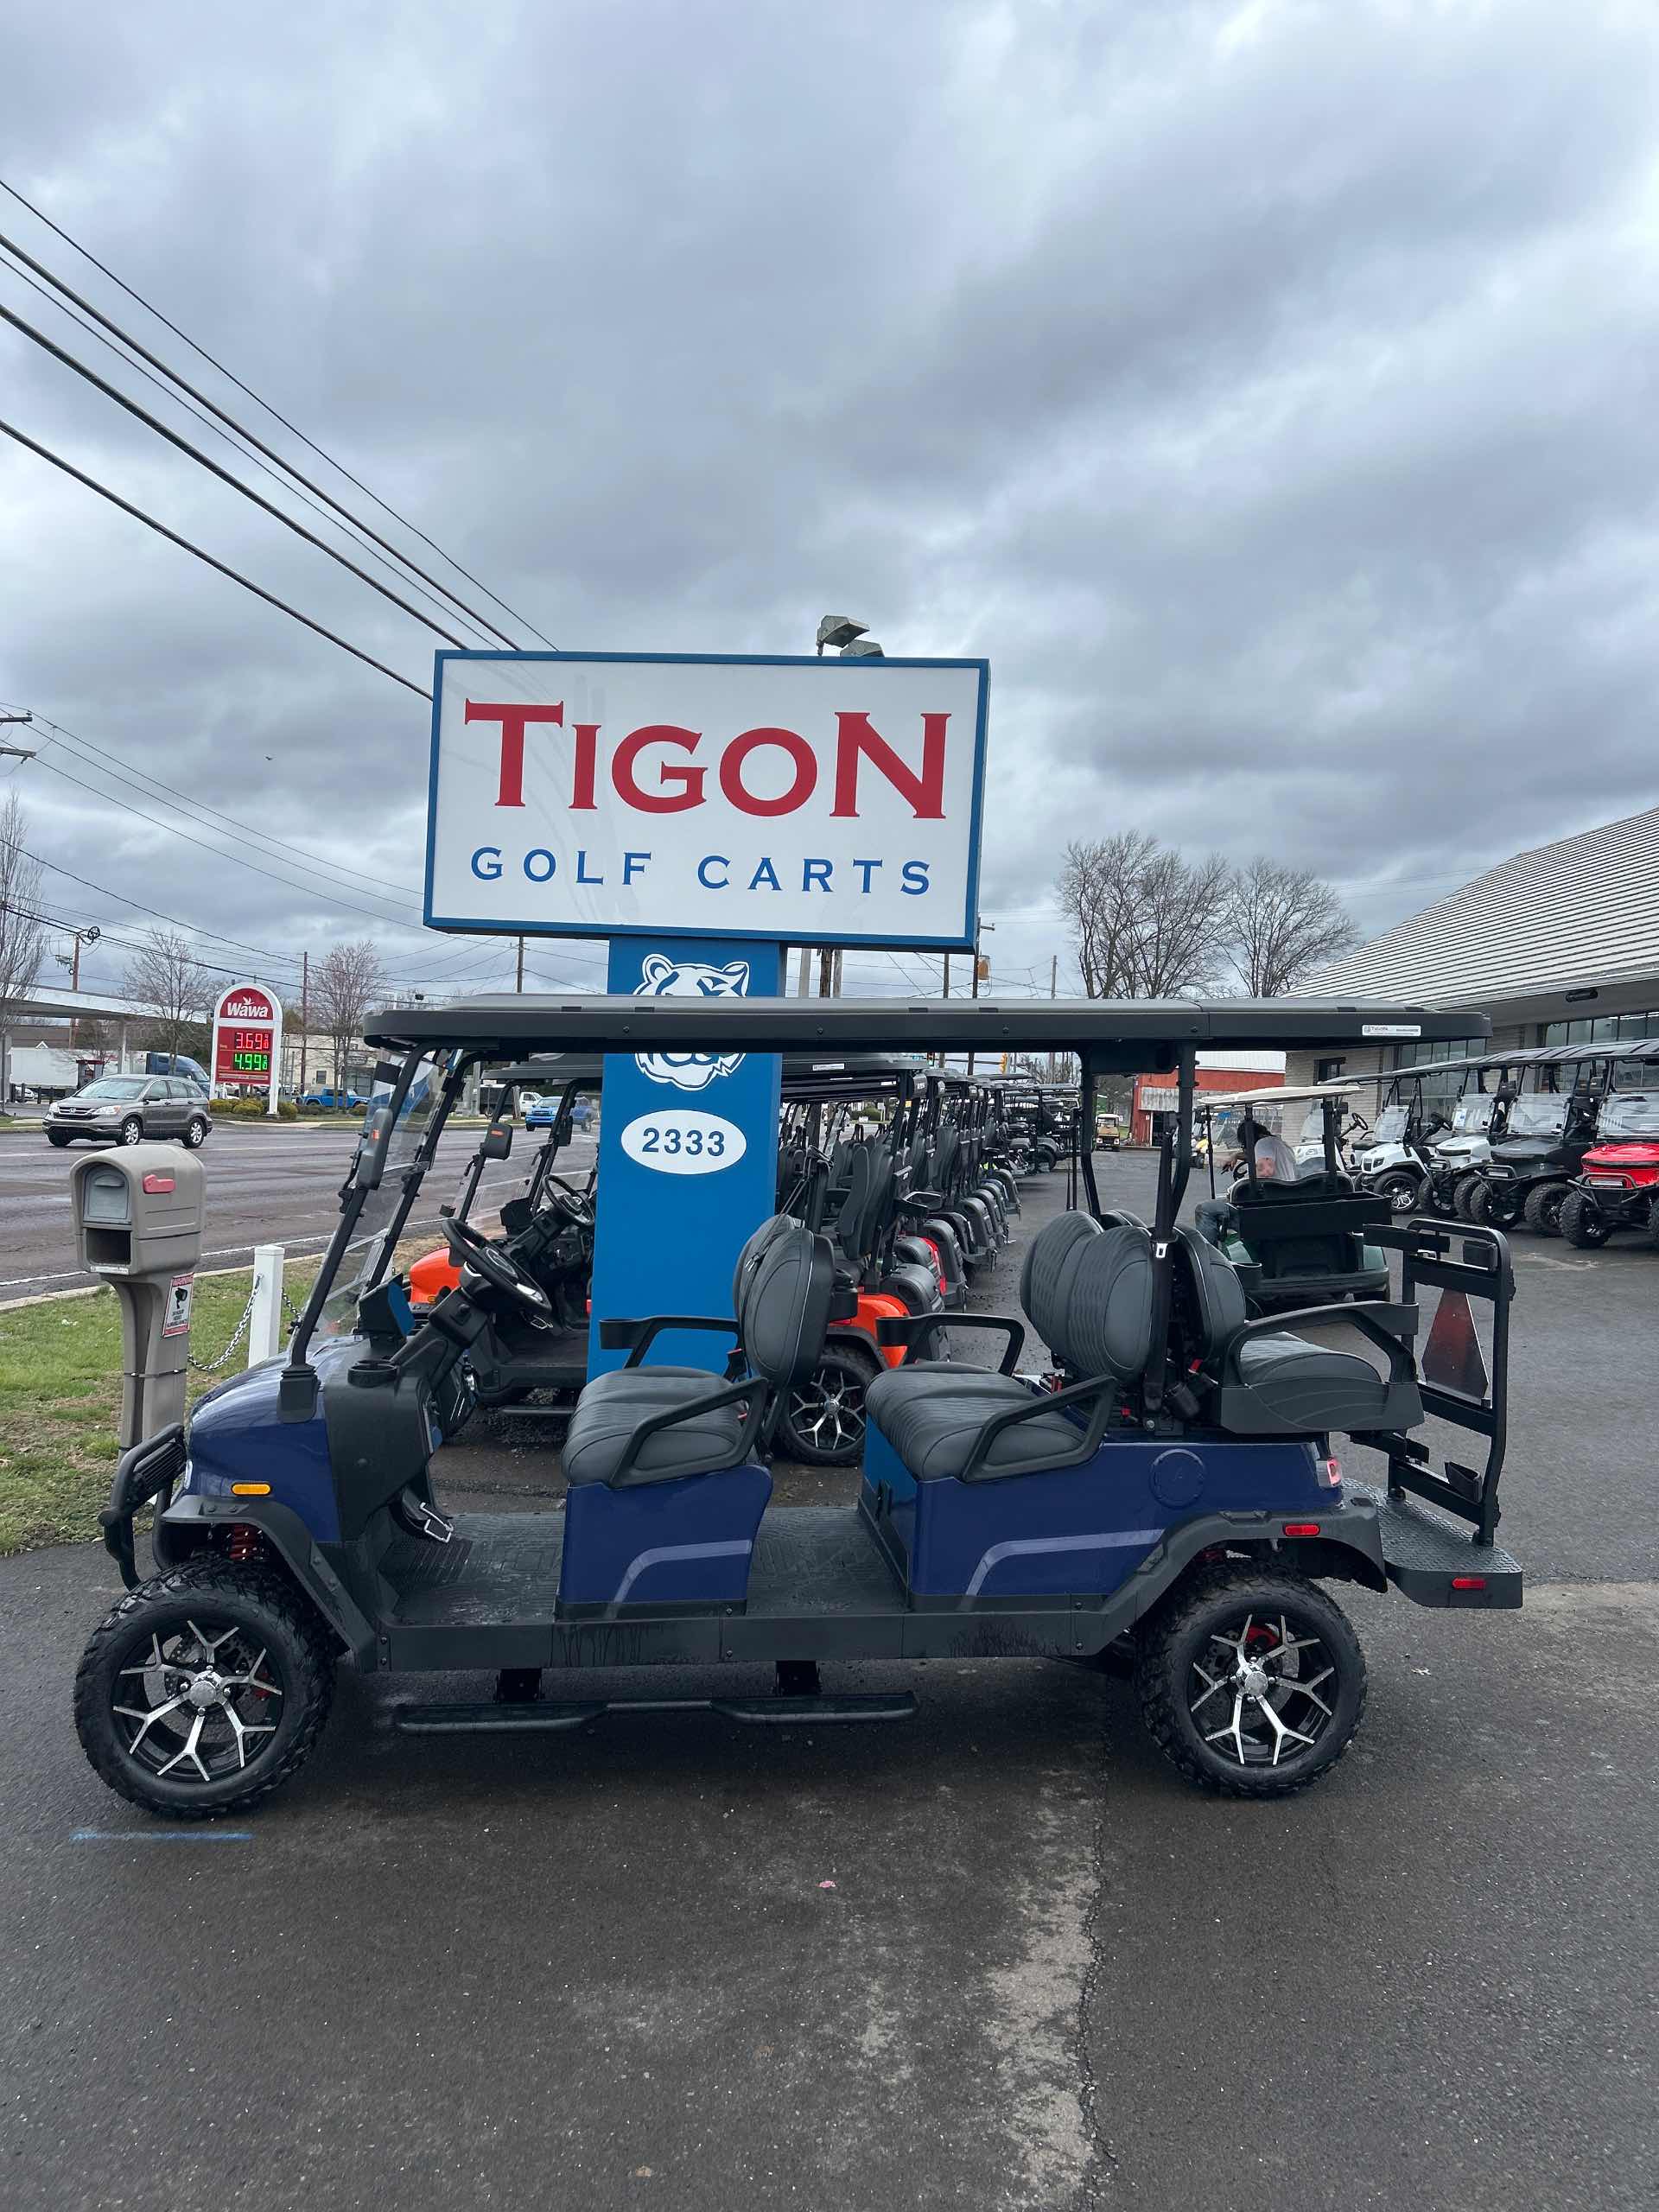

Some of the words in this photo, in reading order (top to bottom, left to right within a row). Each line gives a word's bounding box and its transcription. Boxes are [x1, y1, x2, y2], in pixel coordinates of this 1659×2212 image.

[465, 698, 951, 819] TIGON
[471, 847, 651, 886] GOLF
[696, 855, 931, 895] CARTS
[227, 1001, 269, 1018] Wawa
[641, 1127, 725, 1156] 2333
